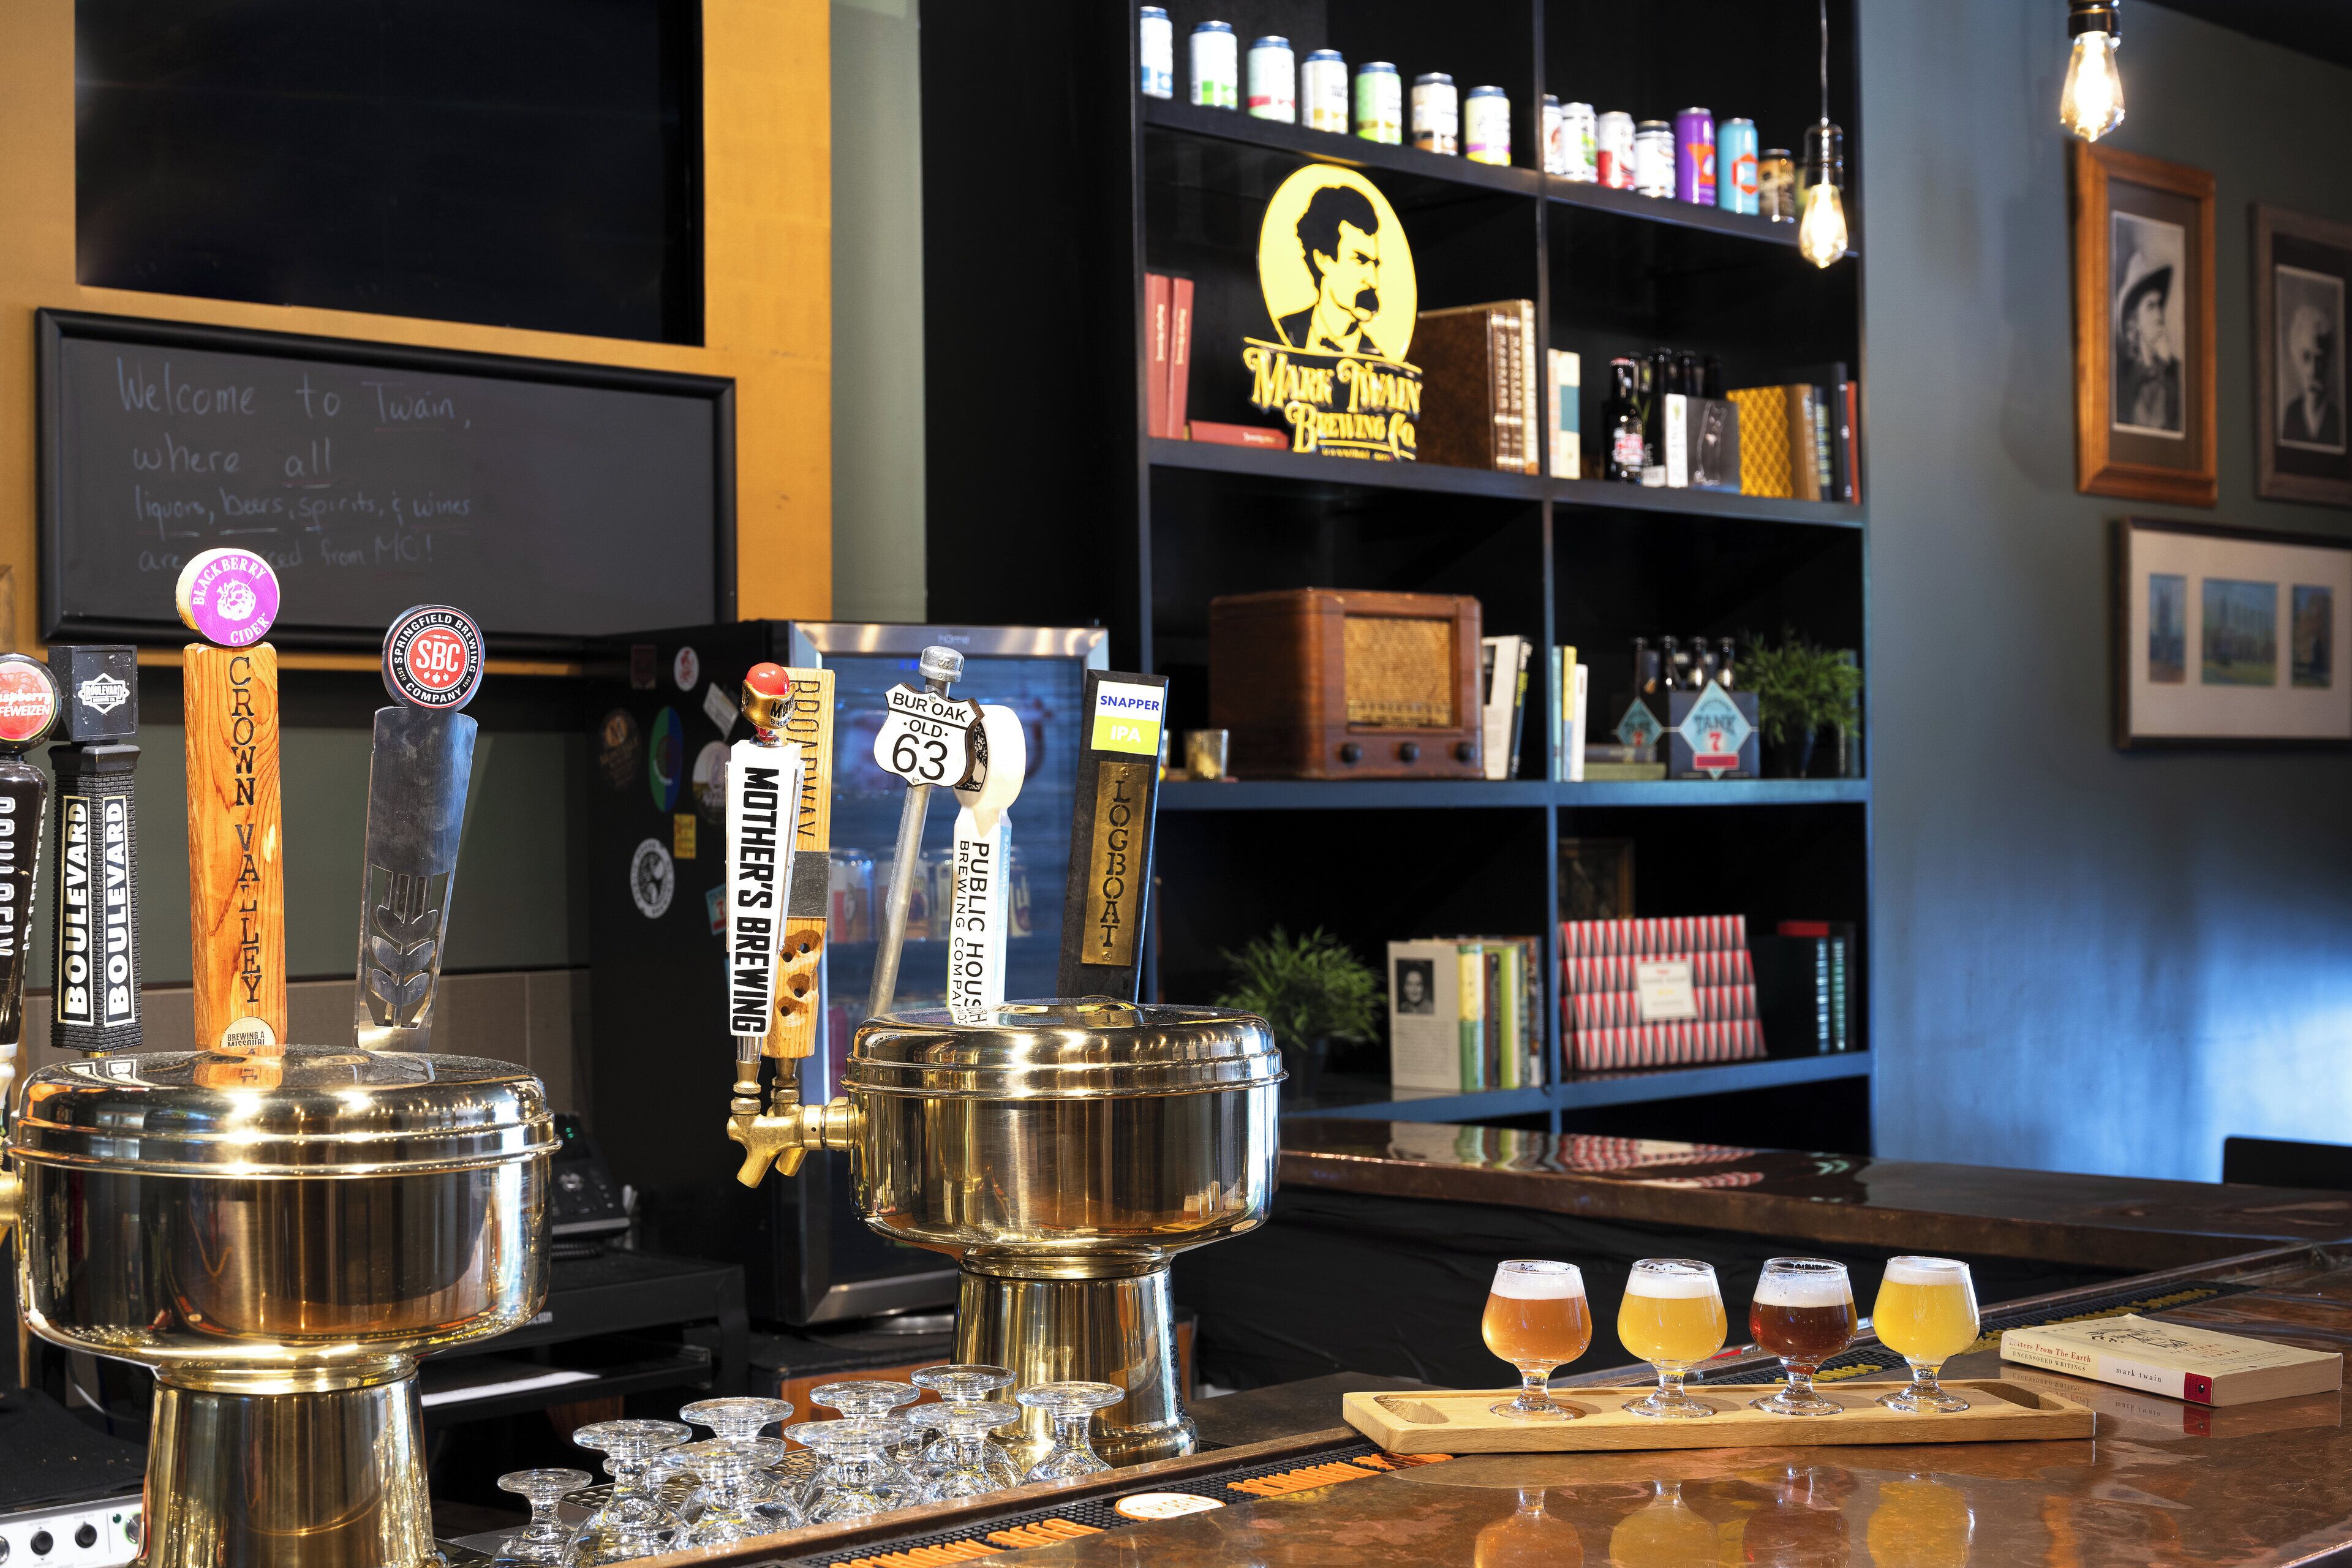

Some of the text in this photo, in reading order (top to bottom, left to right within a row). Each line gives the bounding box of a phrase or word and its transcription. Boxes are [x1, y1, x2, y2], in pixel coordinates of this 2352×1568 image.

[118, 355, 471, 430] Welcome to Twain,
[1243, 347, 1423, 418] MARK TWAIN
[1284, 401, 1386, 454] BREWING
[133, 431, 331, 478] where all
[412, 491, 472, 519] wines
[138, 549, 184, 572] are
[320, 537, 366, 568] from
[192, 557, 268, 606] BLACKBERRY
[230, 616, 270, 644] CIDER
[394, 614, 478, 703] SPRINGFIELD BREWING COMPANY
[415, 639, 461, 672] SBC
[85, 684, 123, 701] BOULEVARD
[462, 675, 472, 689] 1997
[892, 692, 968, 723] BUR OAK
[1100, 695, 1159, 710] SNAPPER
[909, 719, 943, 737] OLD
[1110, 725, 1141, 742] IPA
[892, 733, 948, 780] 63
[229, 655, 260, 1003] CROWN VALLEY
[1101, 780, 1132, 948] LOGBOAT
[64, 803, 89, 1015] BOULEVARD
[105, 802, 130, 1011] BOULEVARD
[732, 767, 780, 1033] MOTHER'S BREWING
[952, 840, 970, 1006] BREWING COMPA
[963, 842, 990, 1007] PUBLIC HOUS
[227, 1031, 258, 1042] BREWING
[227, 1039, 265, 1047] MISSOURI
[2013, 1351, 2086, 1373] UNCENSORED WRITINGS
[2035, 1344, 2053, 1355] From
[2056, 1348, 2069, 1359] The
[2071, 1352, 2092, 1363] Earth
[2116, 1367, 2162, 1383] mark twain
[987, 1518, 1105, 1550] BEER
